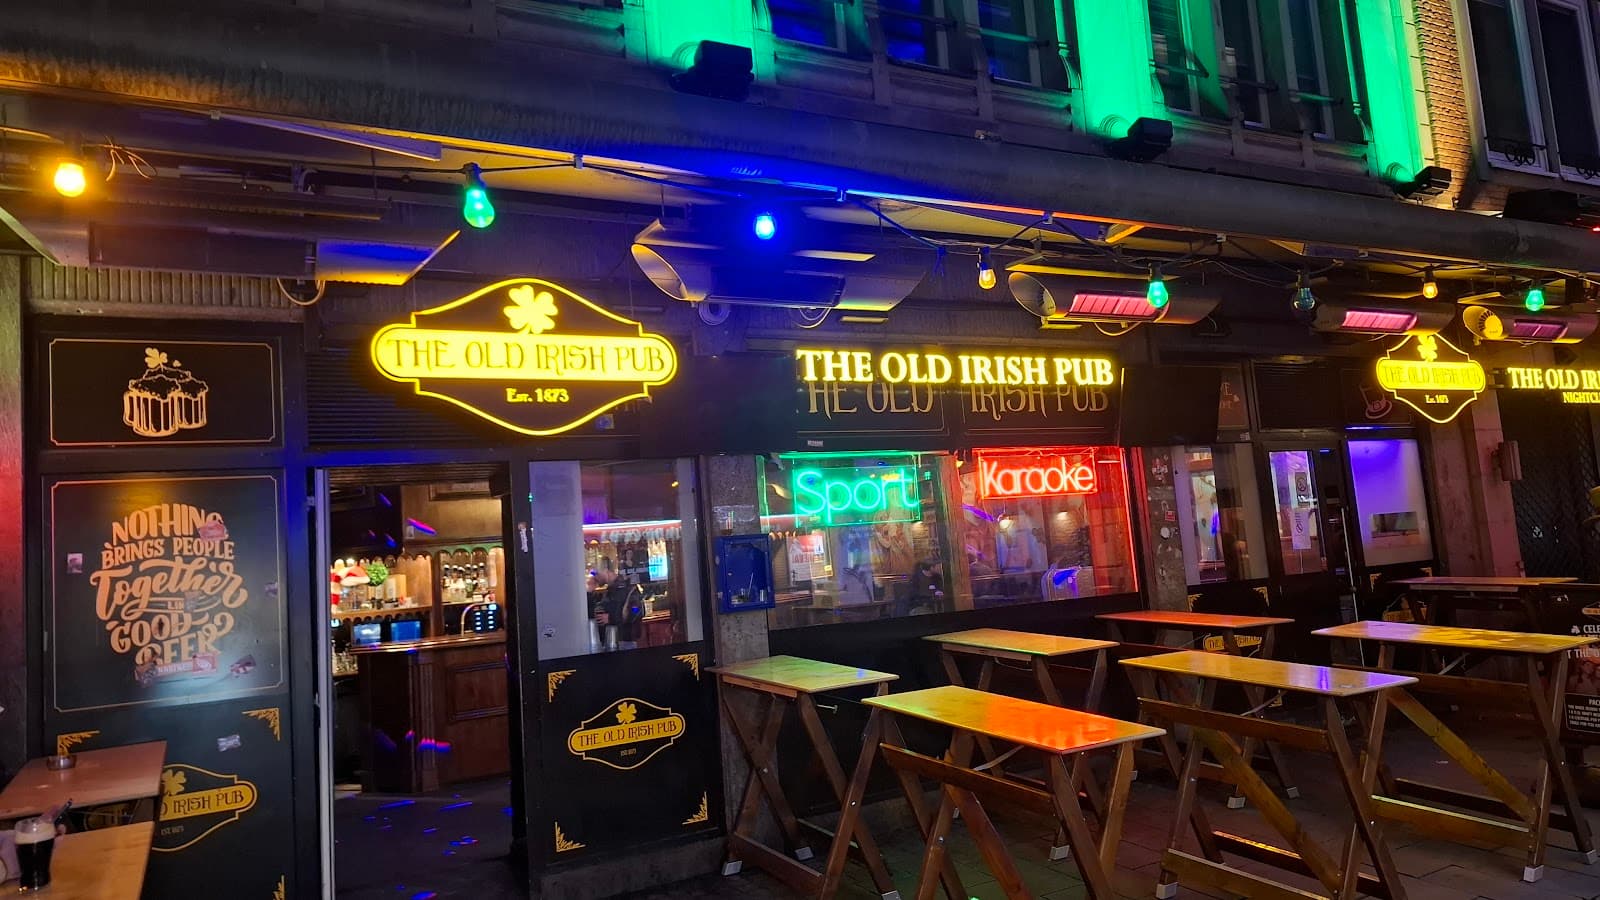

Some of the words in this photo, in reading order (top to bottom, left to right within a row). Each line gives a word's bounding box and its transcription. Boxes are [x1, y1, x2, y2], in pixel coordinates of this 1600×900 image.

[387, 339, 455, 371] THE
[465, 341, 525, 369] OLD
[536, 344, 607, 376] IRISH
[615, 346, 665, 372] PUB
[796, 349, 874, 382] THE
[880, 352, 953, 383] OLD
[958, 355, 1049, 385] IRISH
[1053, 358, 1114, 386] PUB
[534, 387, 570, 403] 1873
[1507, 367, 1544, 389] THE
[1545, 368, 1580, 390] OLD
[866, 381, 934, 413] OLD
[971, 384, 1047, 421] IRISH
[1056, 384, 1108, 412] PUB
[796, 467, 920, 524] Sport
[982, 458, 1095, 497] Karaoke
[102, 538, 165, 570] BRINGS
[173, 536, 234, 560] PEOPLE
[90, 556, 248, 621] Together
[106, 612, 209, 653] GOOD
[578, 733, 601, 747] THE
[603, 729, 625, 742] OLD
[628, 724, 654, 740] IRISH
[657, 719, 677, 733] PUB
[173, 795, 212, 815] IRISH
[215, 790, 244, 806] PUB
